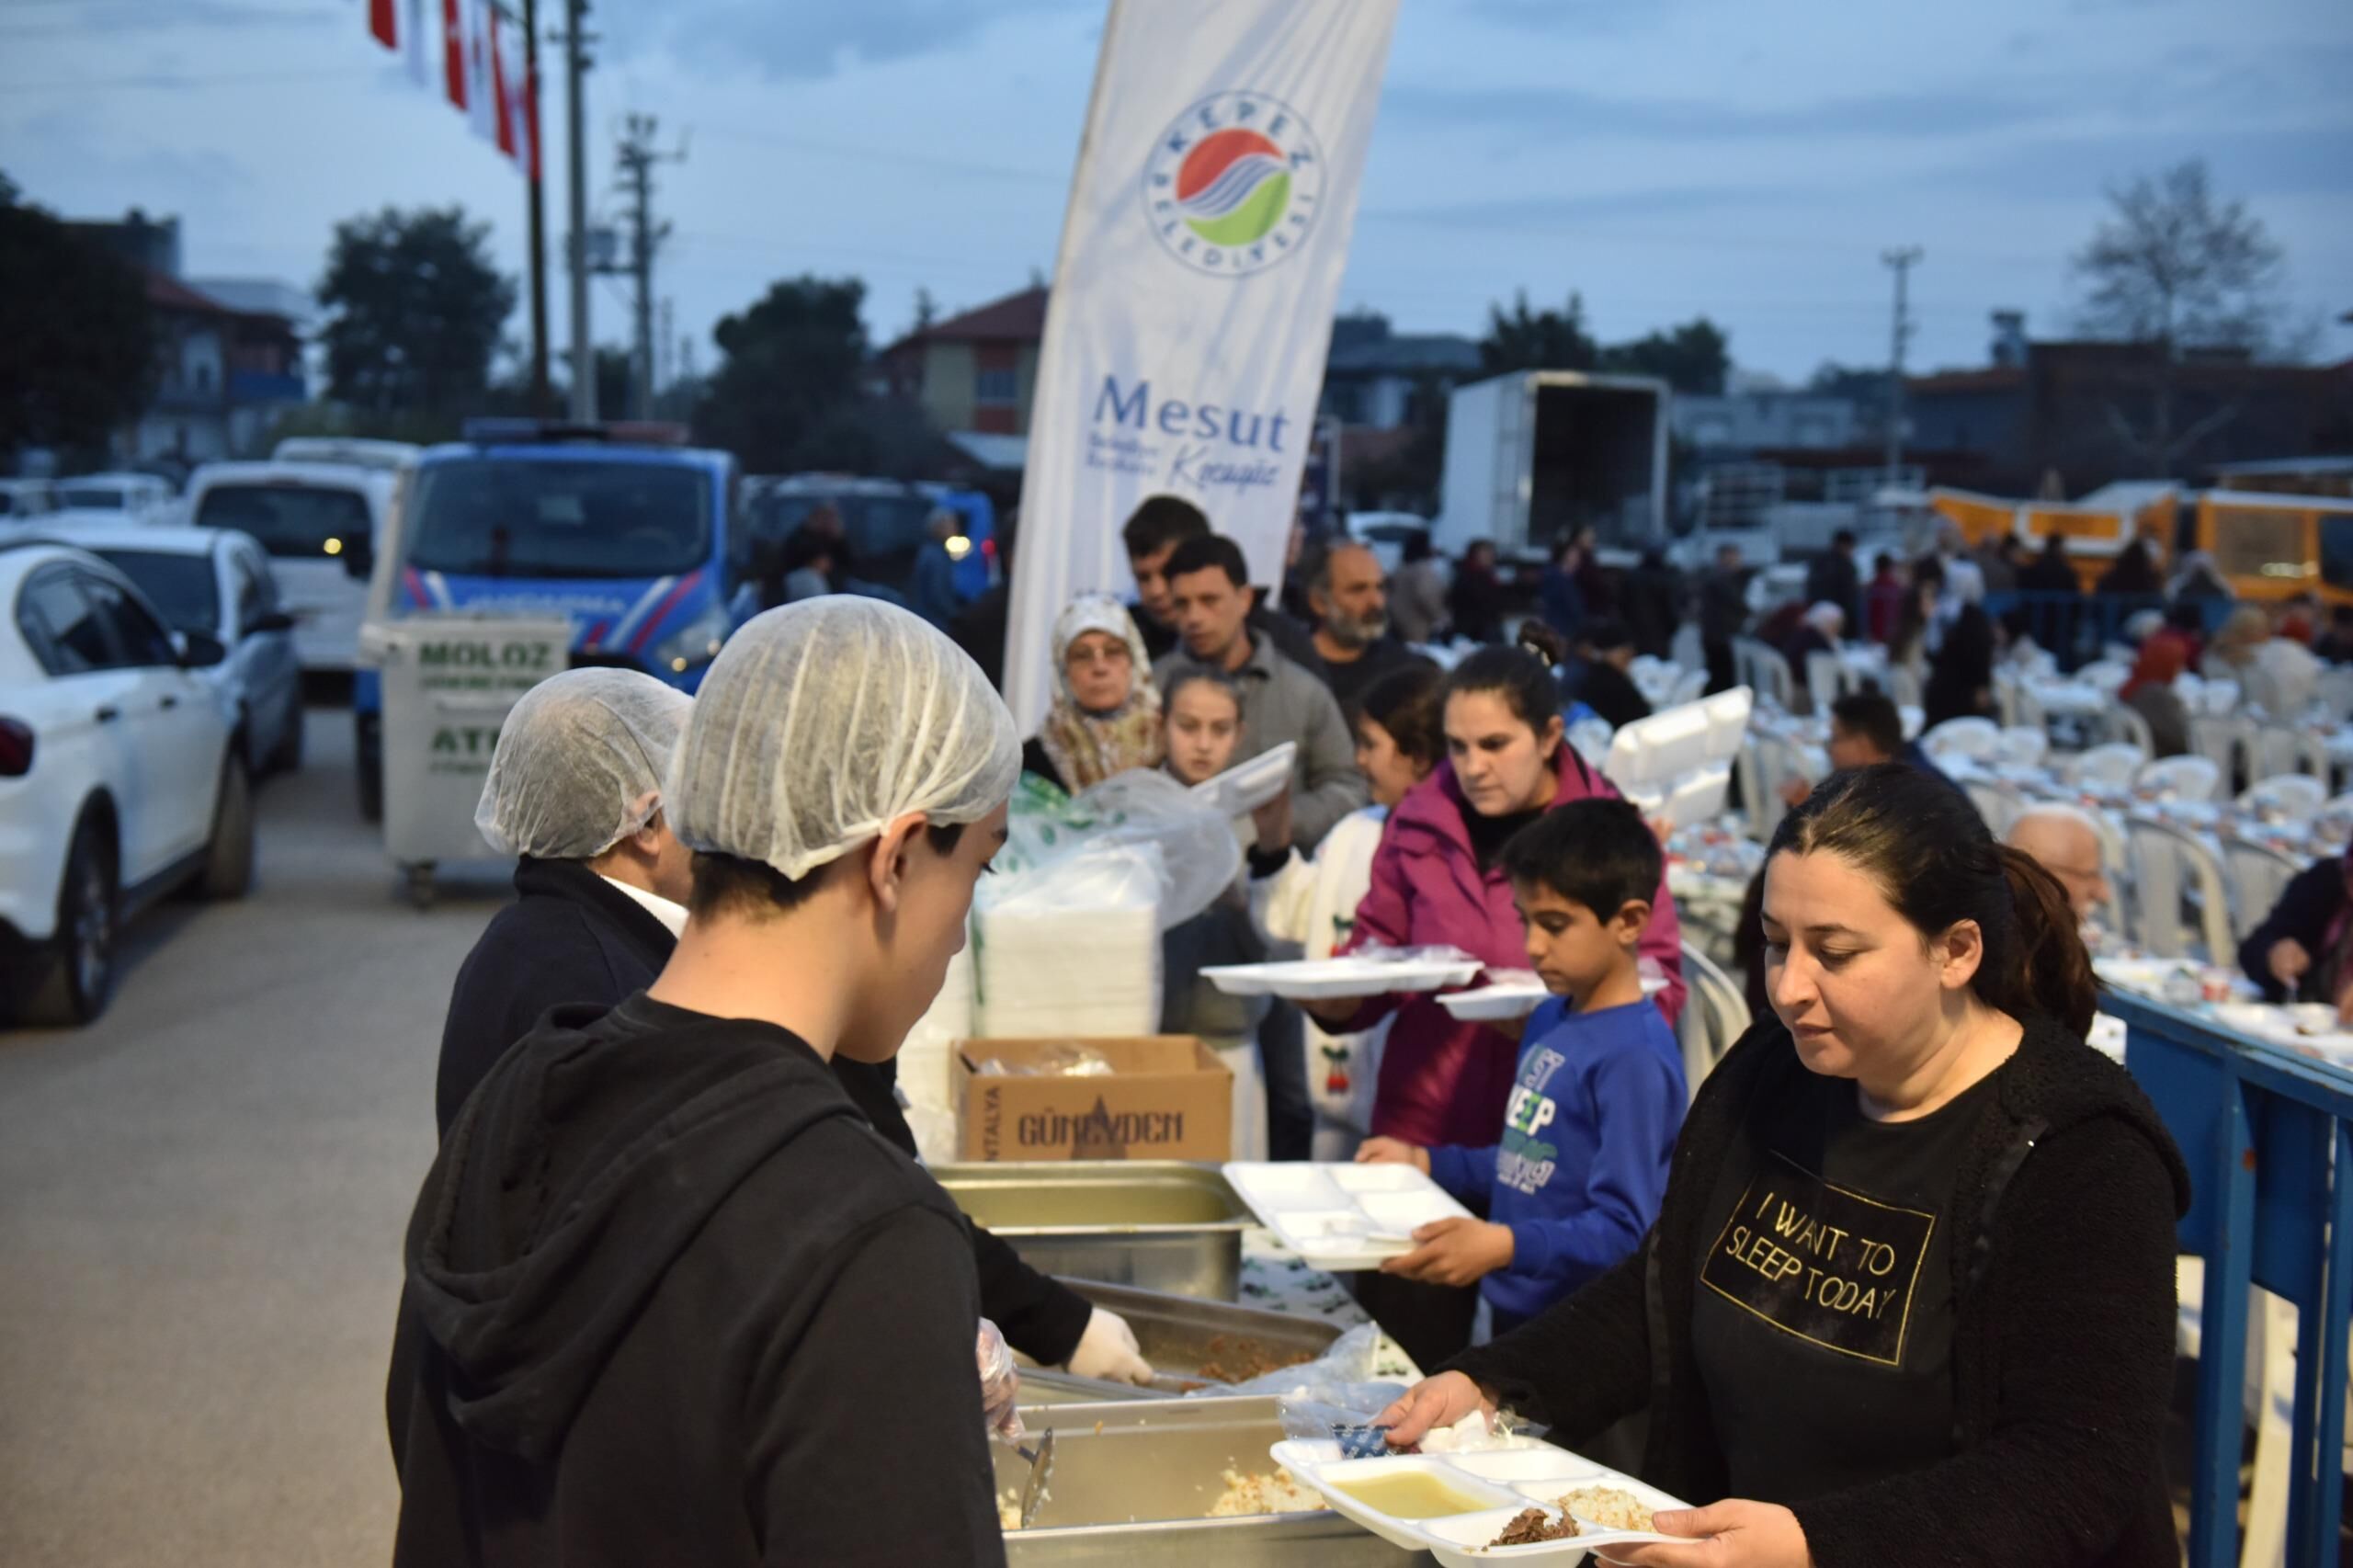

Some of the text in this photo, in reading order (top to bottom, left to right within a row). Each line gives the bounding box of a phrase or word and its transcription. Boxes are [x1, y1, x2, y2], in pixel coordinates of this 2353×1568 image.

[1167, 101, 1313, 169] KEPEZ
[1094, 374, 1290, 453] Mesut
[419, 642, 550, 668] MOLOZ
[983, 1086, 1002, 1162] NTALYA
[1725, 1225, 1897, 1320] SLEEP TODAY
[1756, 1192, 1895, 1276] I WANT TO
